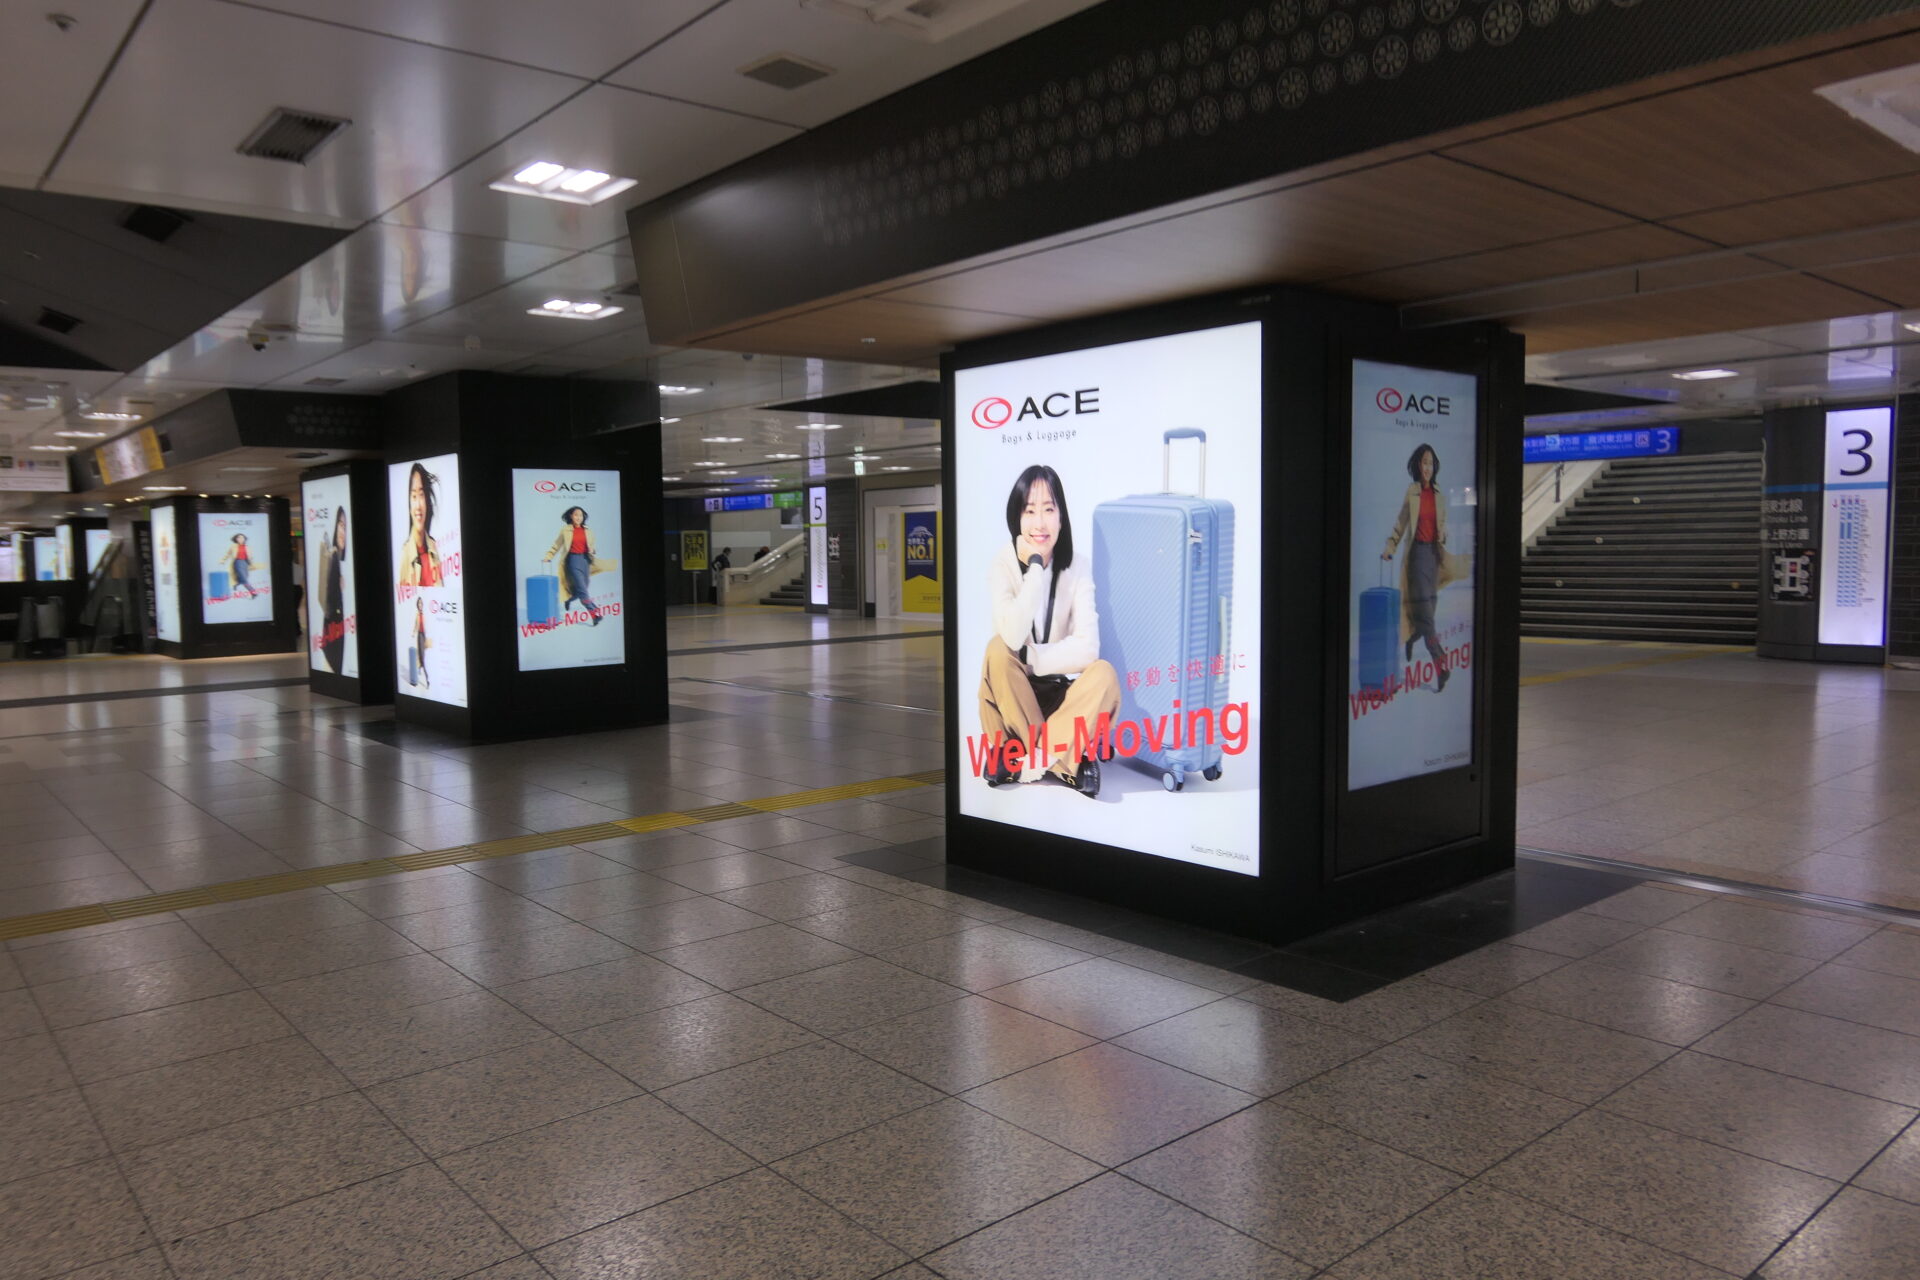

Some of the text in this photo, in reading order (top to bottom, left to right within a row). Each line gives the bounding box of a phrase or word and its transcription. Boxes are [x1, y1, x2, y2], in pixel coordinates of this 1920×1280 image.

[1017, 388, 1099, 422] ACE
[1405, 394, 1450, 415] ACE
[1656, 430, 1671, 453] 3
[1840, 428, 1873, 476] 3
[558, 482, 597, 492] ACE
[814, 497, 823, 521] 5
[396, 552, 461, 603] Well-oving
[440, 602, 457, 614] ACE
[521, 602, 621, 638] Well-Moving
[1126, 653, 1246, 691] 移動を快適に
[1349, 642, 1471, 720] Well-Moving
[967, 700, 1249, 777] Well-Moving
